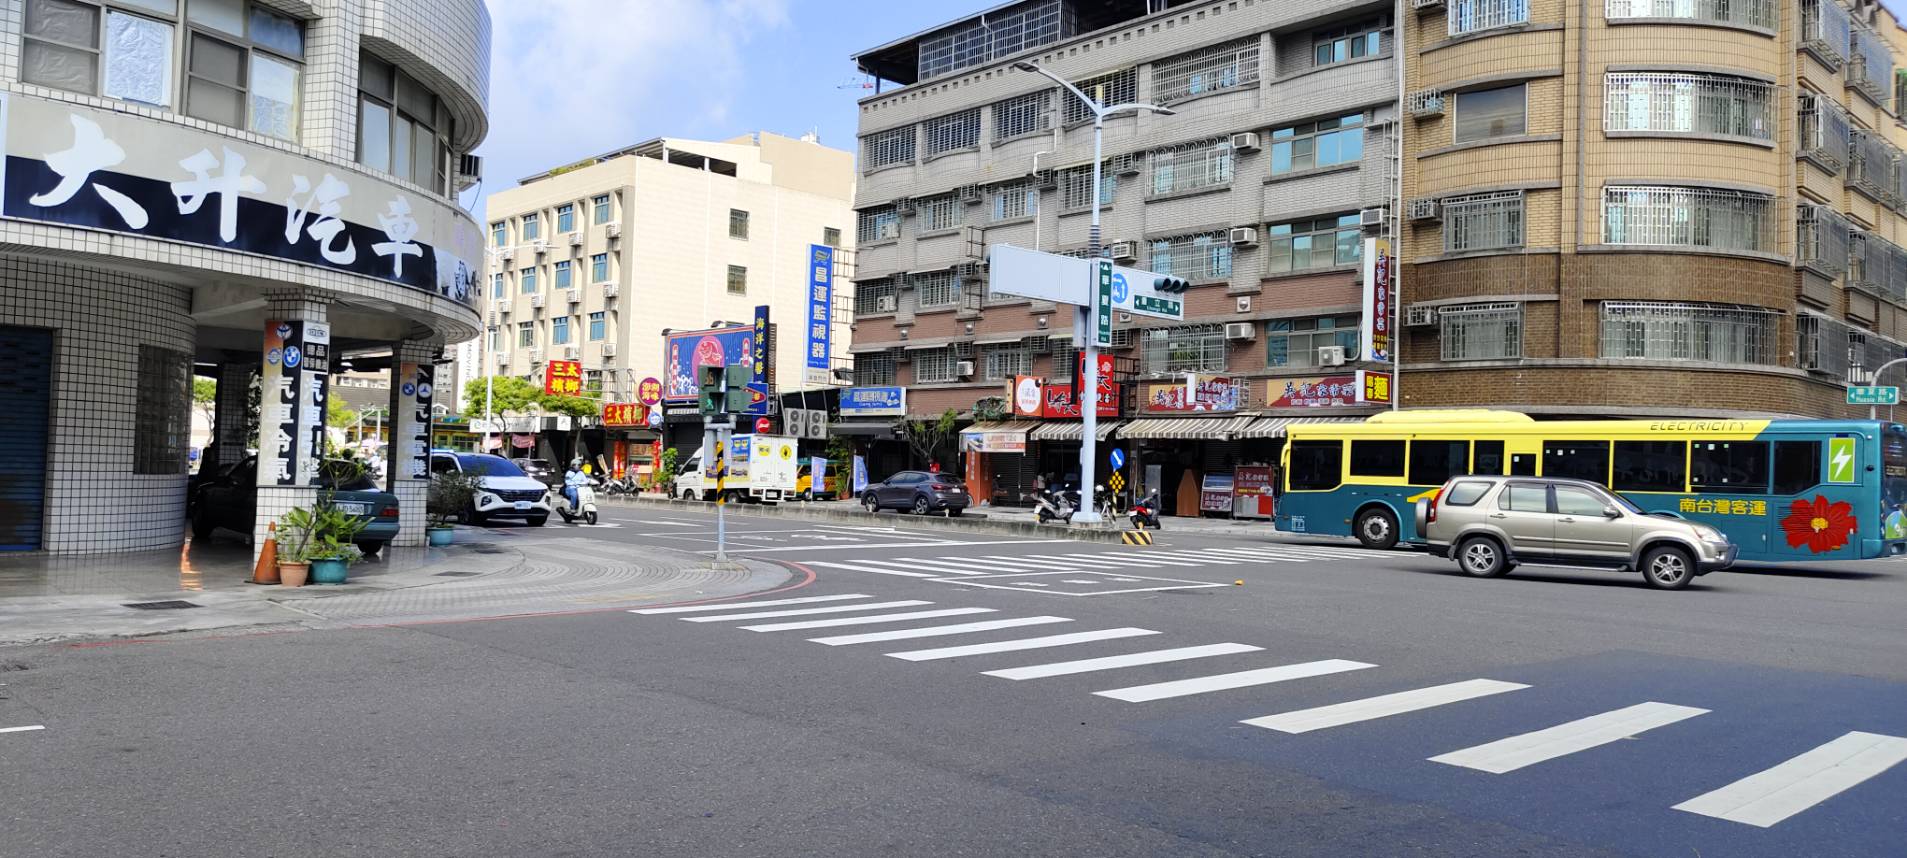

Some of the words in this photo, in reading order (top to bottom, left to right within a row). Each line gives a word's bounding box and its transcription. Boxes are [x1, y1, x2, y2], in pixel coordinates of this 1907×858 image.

[29, 113, 423, 278] 大升汽車
[813, 266, 827, 358] 昌運監視器
[552, 363, 579, 378] 三太
[551, 378, 579, 393] 檳榔
[1650, 422, 1748, 432] ELECTRICITY
[1680, 498, 1767, 516] 南台灣客運
